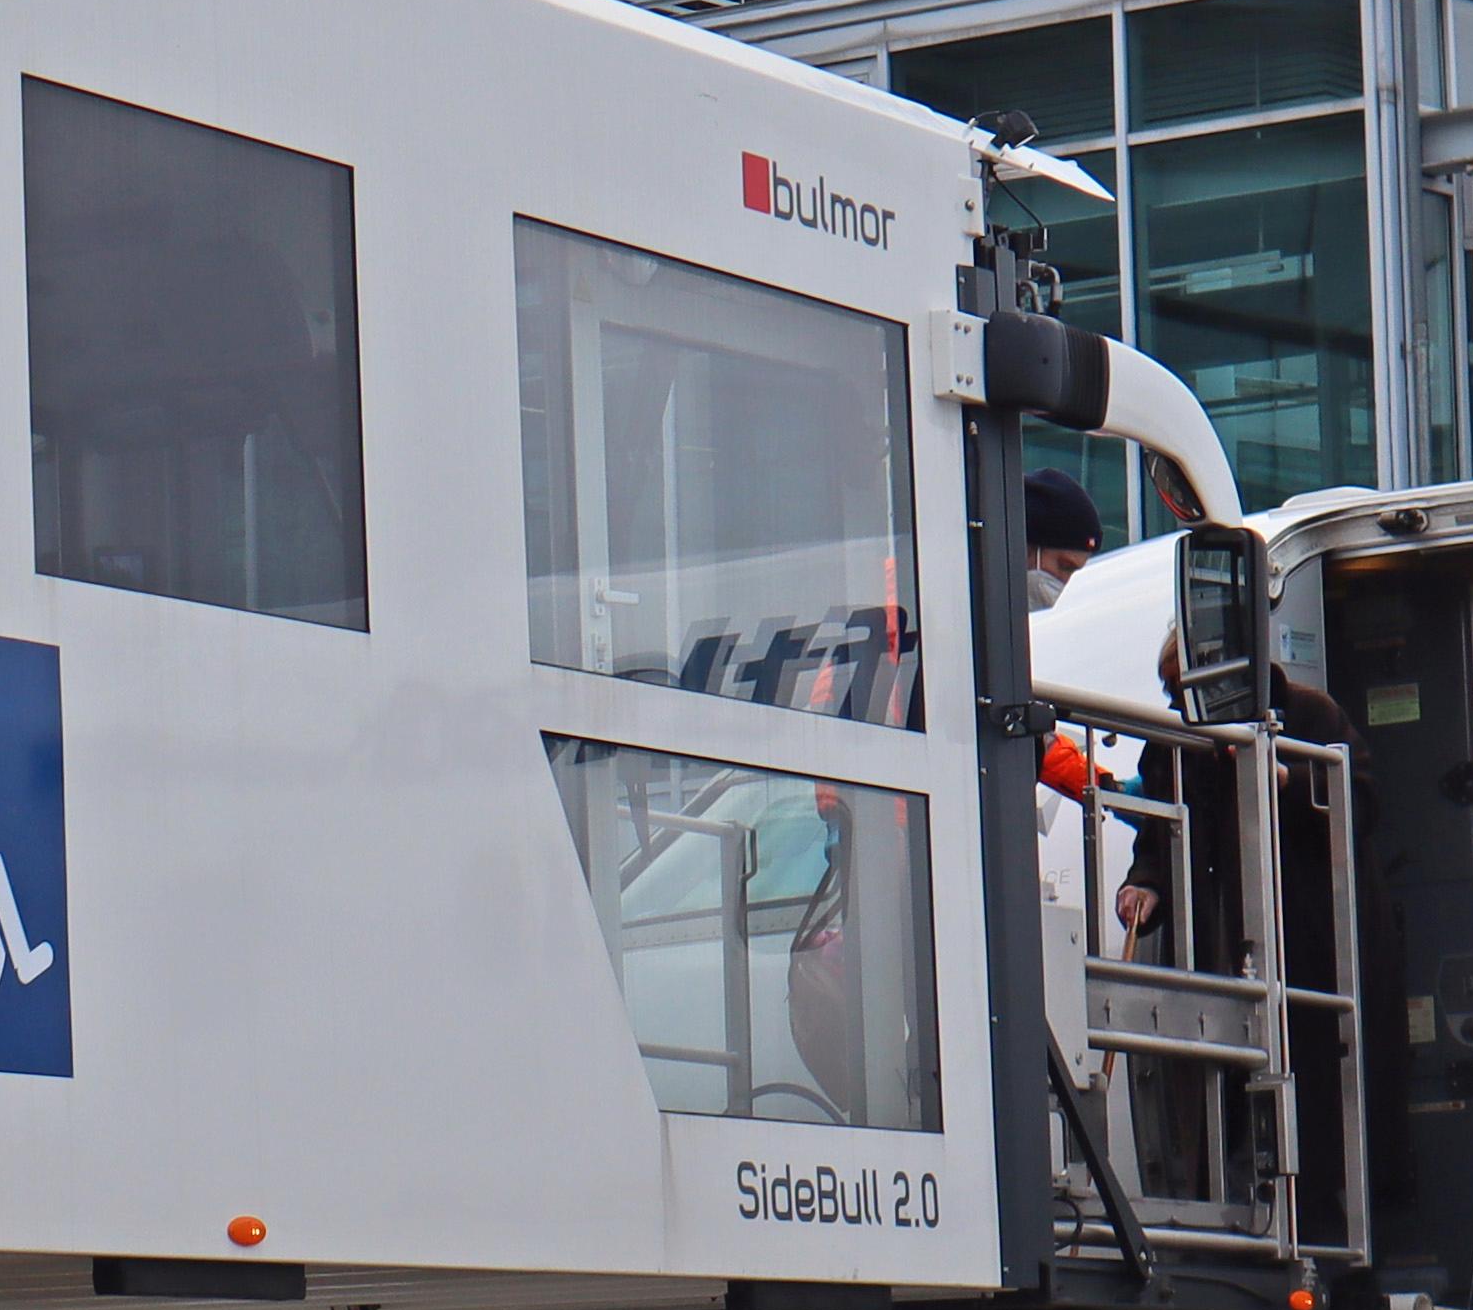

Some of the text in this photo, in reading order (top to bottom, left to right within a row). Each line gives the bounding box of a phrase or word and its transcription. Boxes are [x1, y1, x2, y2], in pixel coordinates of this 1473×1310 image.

[771, 159, 896, 251] bulmor
[736, 1160, 940, 1229] SideBull 2.0
